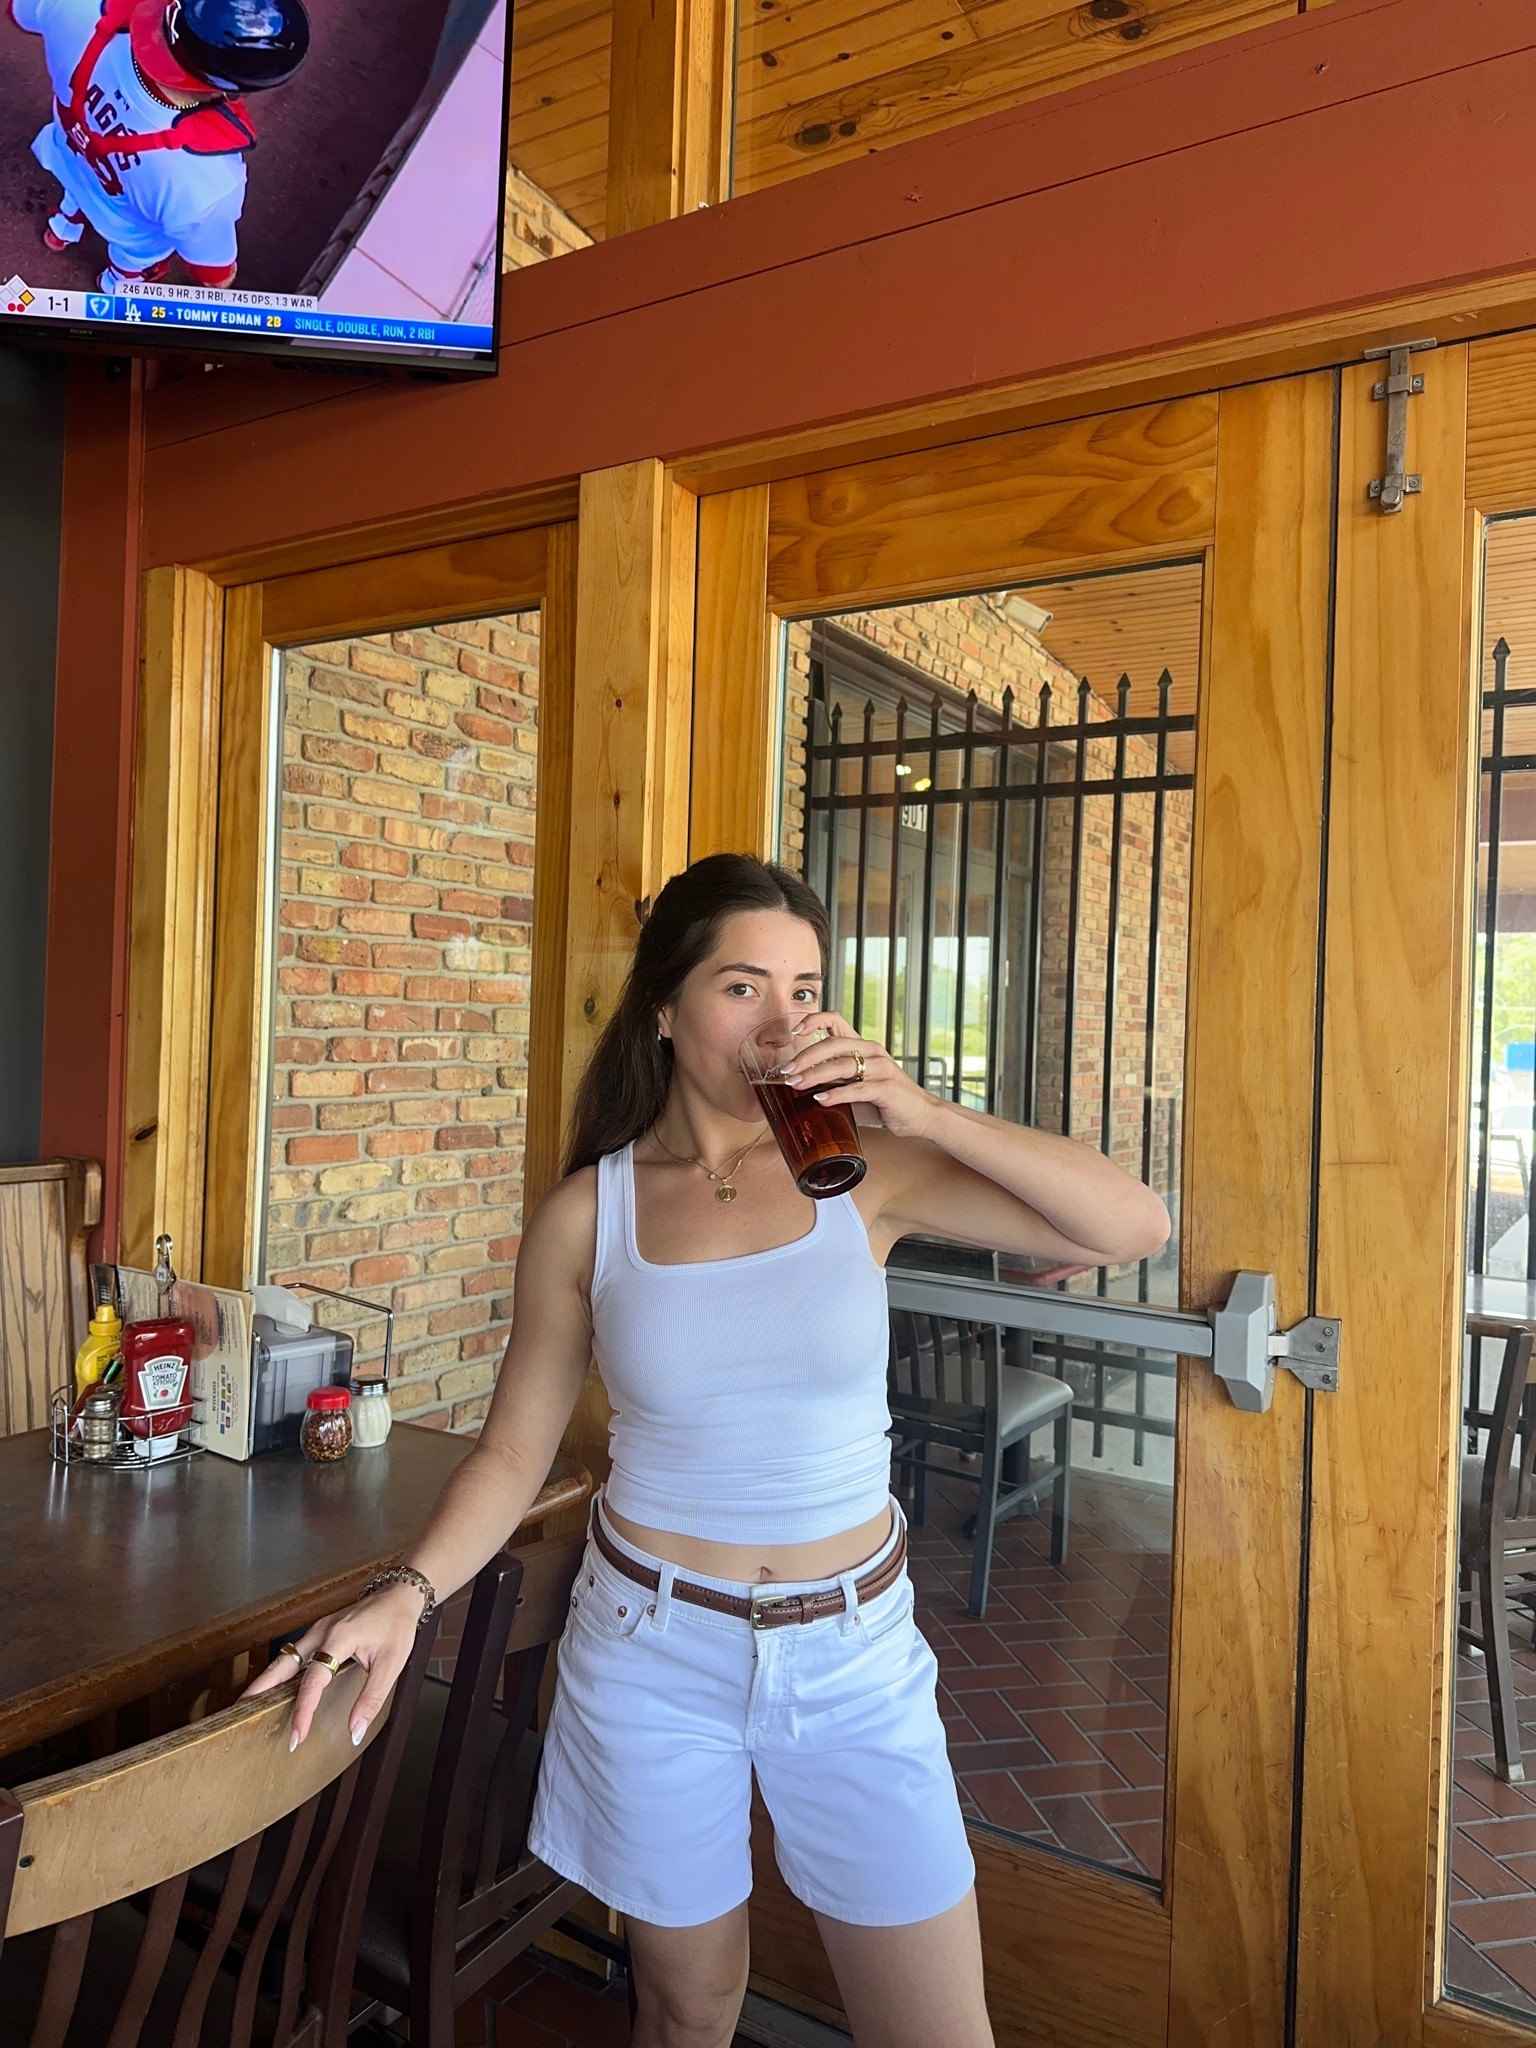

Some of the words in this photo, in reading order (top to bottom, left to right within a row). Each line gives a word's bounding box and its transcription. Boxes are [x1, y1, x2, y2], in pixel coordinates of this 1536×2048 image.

[48, 296, 69, 312] 1-1
[143, 286, 166, 298] AVG,
[168, 288, 174, 297] 9
[176, 289, 193, 300] HR,
[195, 290, 205, 300] 31
[208, 291, 227, 302] RBI,
[228, 293, 249, 303] .745
[251, 295, 273, 307] OPS,
[276, 297, 288, 307] 1.3
[291, 298, 313, 309] WAR
[151, 306, 166, 319] 25
[176, 308, 218, 323] TOMMY
[221, 312, 261, 327] EDMAN
[266, 315, 282, 328] 2B
[294, 317, 335, 334] SINGLE,
[337, 320, 381, 337] DOUBLE,
[383, 324, 407, 340] RUN,
[409, 327, 415, 339] 2
[417, 327, 435, 340] RBI
[153, 1362, 176, 1372] HEINZ
[152, 1372, 178, 1382] TOMATO
